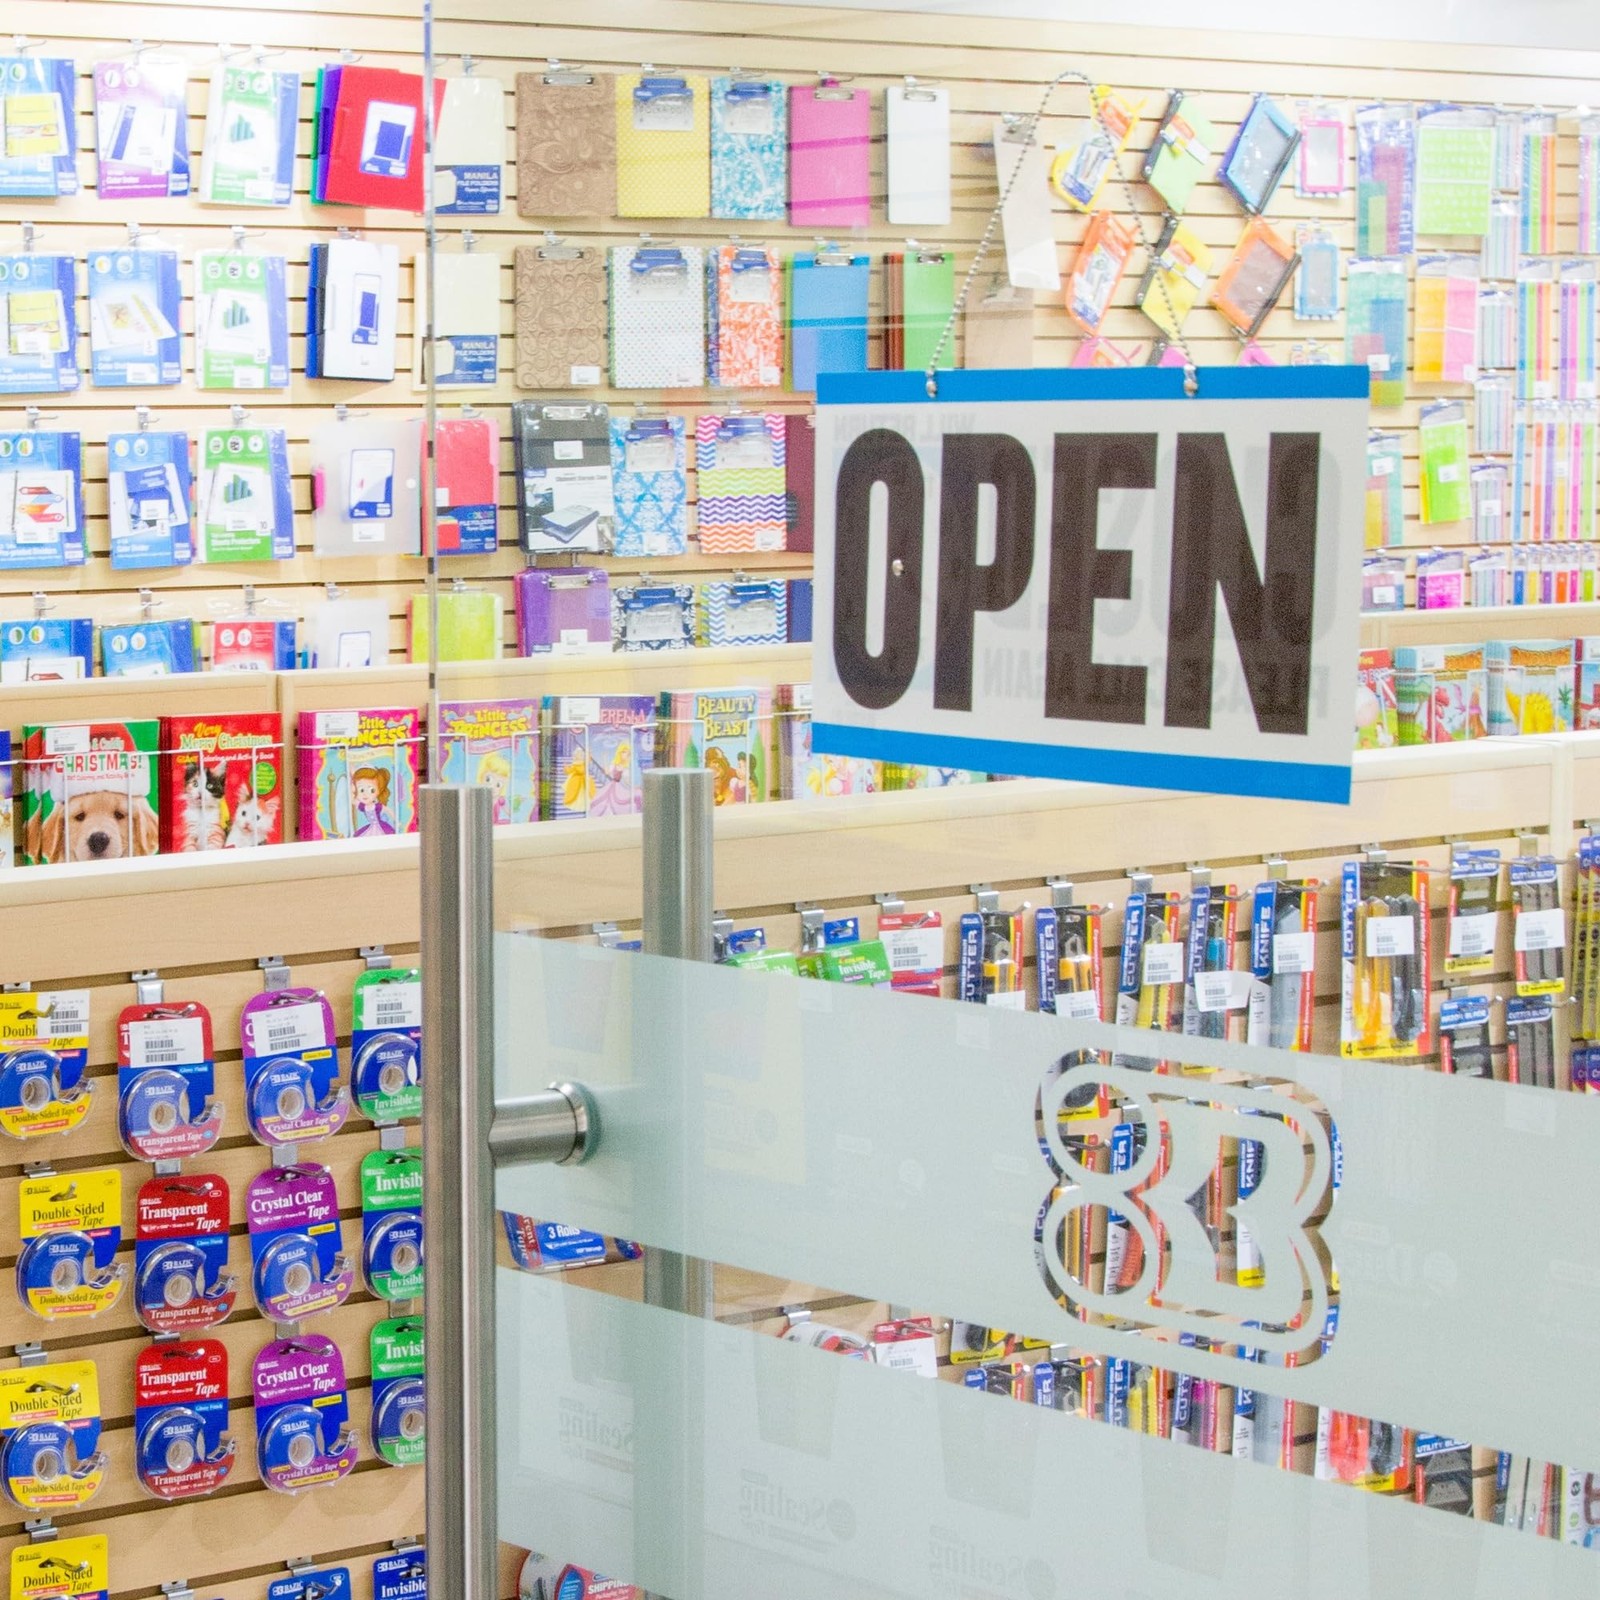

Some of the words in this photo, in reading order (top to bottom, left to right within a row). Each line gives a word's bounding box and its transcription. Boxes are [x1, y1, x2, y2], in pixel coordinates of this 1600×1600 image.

[463, 171, 498, 180] MANILA
[462, 341, 496, 349] MANILA
[833, 428, 1321, 736] OPEN
[697, 694, 756, 718] BEAUTY
[474, 708, 507, 722] Little
[600, 708, 646, 725] ERELLA
[450, 717, 528, 738] PRINCESS
[704, 716, 749, 741] BEAST
[179, 733, 219, 754] Merry
[217, 732, 273, 750] Christmas
[54, 752, 142, 773] CHRISTMAS!
[1343, 879, 1354, 954] CUTTER
[1260, 906, 1271, 968] KNIFE
[1127, 909, 1140, 986] CUTTER
[838, 959, 877, 975] Invisible
[868, 969, 887, 979] Tape
[2, 1025, 38, 1039] Doubl
[52, 1036, 75, 1050] Tape
[1345, 1042, 1353, 1056] 4
[374, 1093, 413, 1110] Invisible
[12, 1112, 38, 1124] Double
[39, 1109, 59, 1120] Sided
[61, 1107, 76, 1118] Tape
[267, 1121, 293, 1133] Crystal
[294, 1118, 315, 1128] Clear
[315, 1115, 329, 1126] Tape
[137, 1133, 186, 1147] Transparent
[187, 1131, 203, 1142] Tape
[1246, 1139, 1255, 1188] KNIF
[376, 1171, 423, 1192] Invisib
[251, 1194, 293, 1214] Crystal
[295, 1190, 324, 1206] Clear
[32, 1207, 71, 1222] Double
[74, 1202, 105, 1216] Sided
[140, 1202, 208, 1221] Transparent
[307, 1204, 330, 1220] Tape
[83, 1215, 105, 1227] Tape
[196, 1217, 221, 1232] Tape
[398, 1228, 417, 1238] BAZIC
[547, 1226, 556, 1239] 3
[556, 1224, 580, 1237] Rolls
[59, 1243, 80, 1252] BAZIC
[287, 1248, 307, 1260] BAZIC
[172, 1259, 194, 1268] BAZIC
[39, 1294, 66, 1305] Double
[67, 1292, 87, 1302] Sided
[88, 1291, 104, 1301] Tape
[277, 1298, 302, 1311] Crystal
[303, 1292, 322, 1304] Clear
[322, 1288, 337, 1299] Tape
[151, 1306, 200, 1320] Transparent
[201, 1304, 217, 1315] Tape
[386, 1340, 424, 1360] Invisi
[140, 1368, 207, 1387] Transparent
[257, 1367, 298, 1387] Crystal
[299, 1363, 329, 1377] Clear
[195, 1382, 220, 1398] Tape
[313, 1377, 336, 1392] Tape
[10, 1398, 49, 1413] Double
[52, 1392, 82, 1407] Sided
[1179, 1373, 1189, 1422] CUTT
[60, 1406, 82, 1419] Tape
[173, 1424, 194, 1433] BAZIC
[290, 1419, 310, 1431] BAZIC
[38, 1432, 59, 1441] BAZIC
[394, 1440, 425, 1454] Invisi
[1416, 1442, 1442, 1454] UTILITY
[154, 1471, 201, 1486] Transparent
[202, 1469, 218, 1479] Tape
[277, 1469, 303, 1481] Crystal
[304, 1465, 324, 1476] Clear
[324, 1462, 338, 1473] Tape
[22, 1483, 48, 1494] Double
[50, 1481, 70, 1492] Sided
[70, 1480, 86, 1491] Tape
[388, 1558, 408, 1570] BAZIC
[23, 1571, 61, 1588] Double
[64, 1566, 93, 1581] Sided
[72, 1580, 93, 1593] Tape
[284, 1581, 303, 1593] BAZIC
[588, 1580, 630, 1594] SHIPPIN
